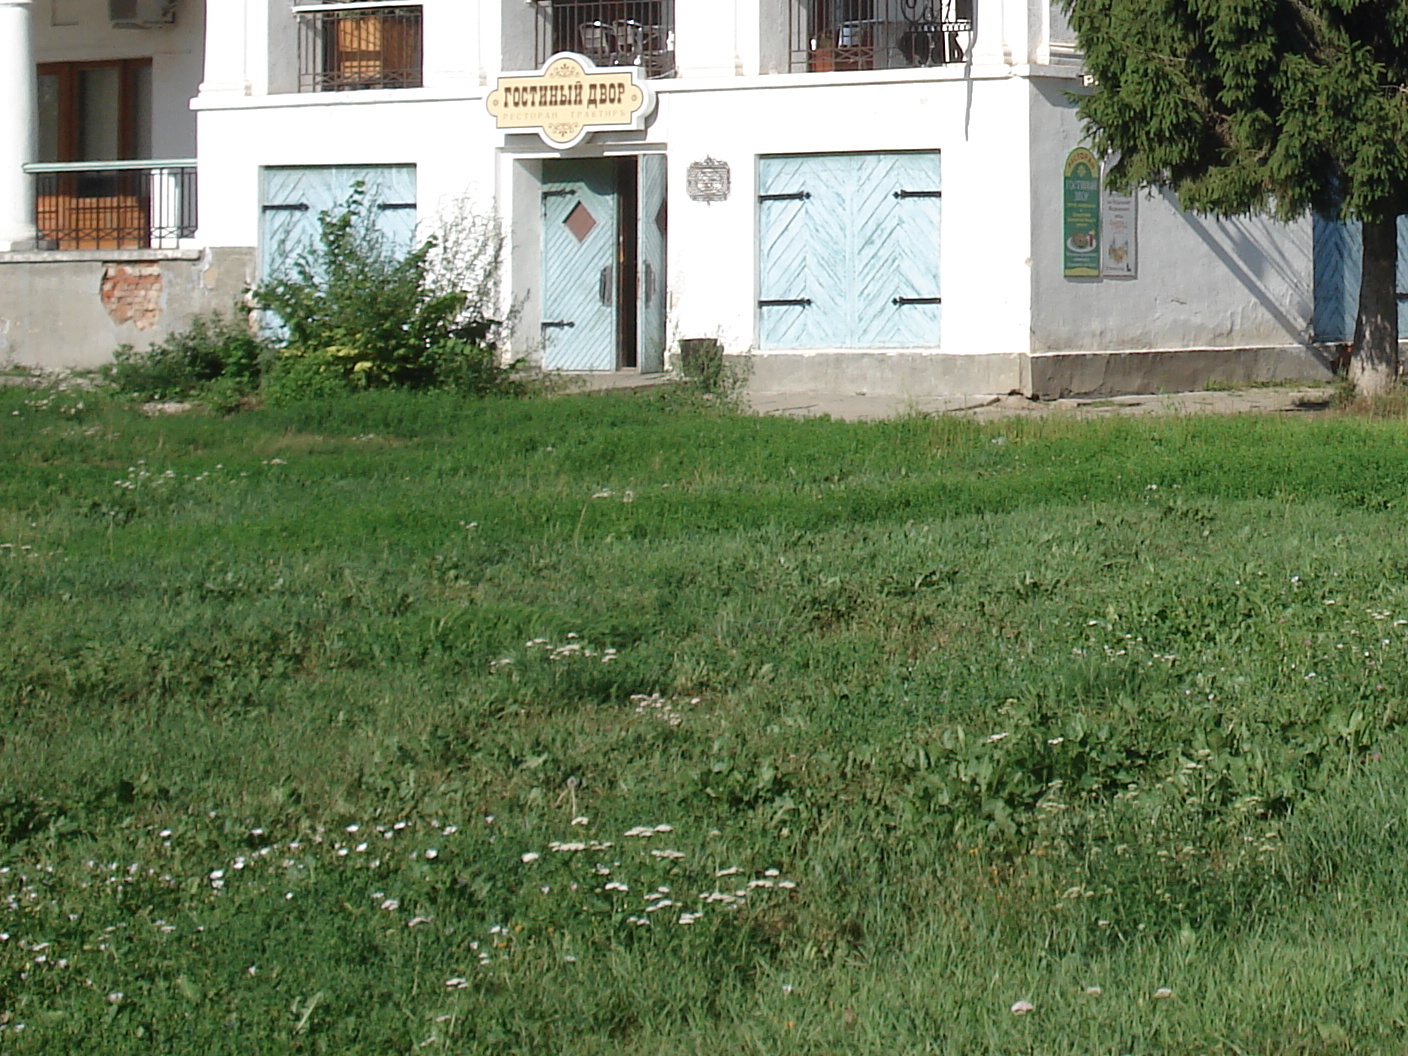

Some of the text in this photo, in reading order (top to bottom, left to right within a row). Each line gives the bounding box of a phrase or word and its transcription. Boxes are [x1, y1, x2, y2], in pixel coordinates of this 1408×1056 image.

[503, 81, 625, 109] ГОСТИНЫЙ ДВОР
[503, 112, 558, 121] РЕСТОРАН
